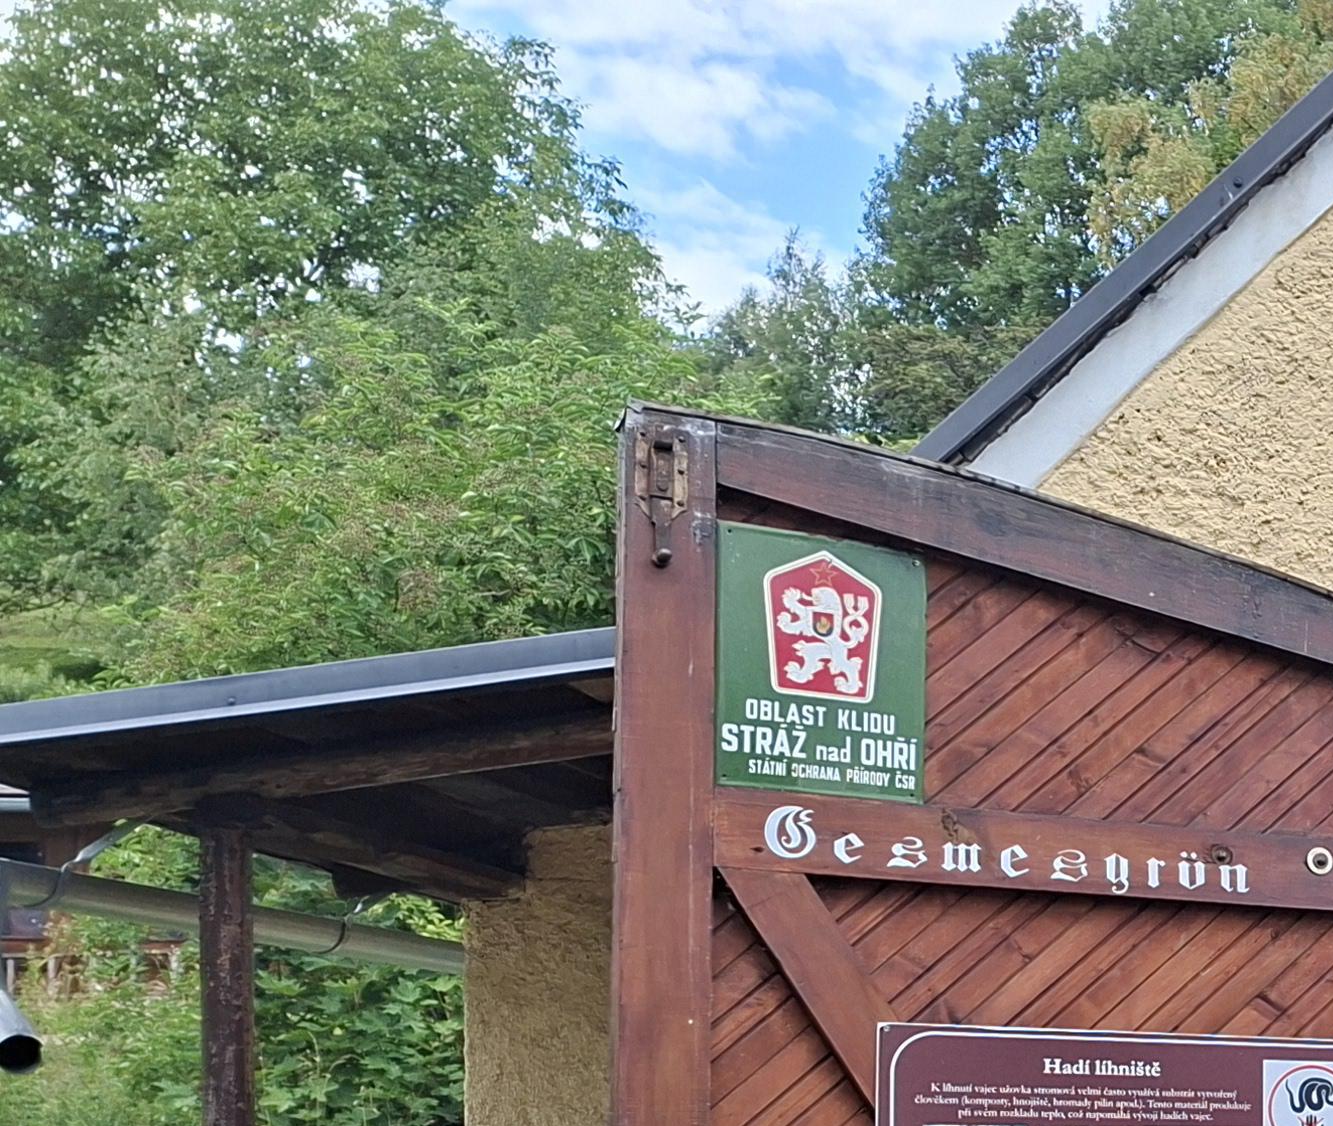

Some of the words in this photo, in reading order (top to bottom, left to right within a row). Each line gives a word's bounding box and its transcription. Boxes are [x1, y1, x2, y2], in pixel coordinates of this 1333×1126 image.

[746, 698, 827, 727] OBLAST
[838, 709, 895, 735] KLIDU
[721, 723, 807, 758] STRÁŽ
[816, 736, 851, 763] nad
[861, 737, 918, 771] OHŘÍ
[749, 758, 787, 777] STÁTNÍ
[792, 763, 841, 782] OCHRANA
[847, 766, 890, 788] PŘÍRODY
[895, 773, 915, 790] ČSR
[764, 805, 1250, 895] Gesmesgrön
[1043, 1057, 1090, 1076] Hadí
[1095, 1058, 1161, 1077] líhniště
[974, 1084, 997, 1095] vajec
[999, 1083, 1031, 1094] užovka
[1034, 1084, 1075, 1095] stromová
[1077, 1086, 1101, 1096] velmi
[1103, 1086, 1126, 1096] často
[974, 1108, 998, 1117] svém
[1067, 1109, 1084, 1119] což
[1148, 1099, 1173, 1109] Tento
